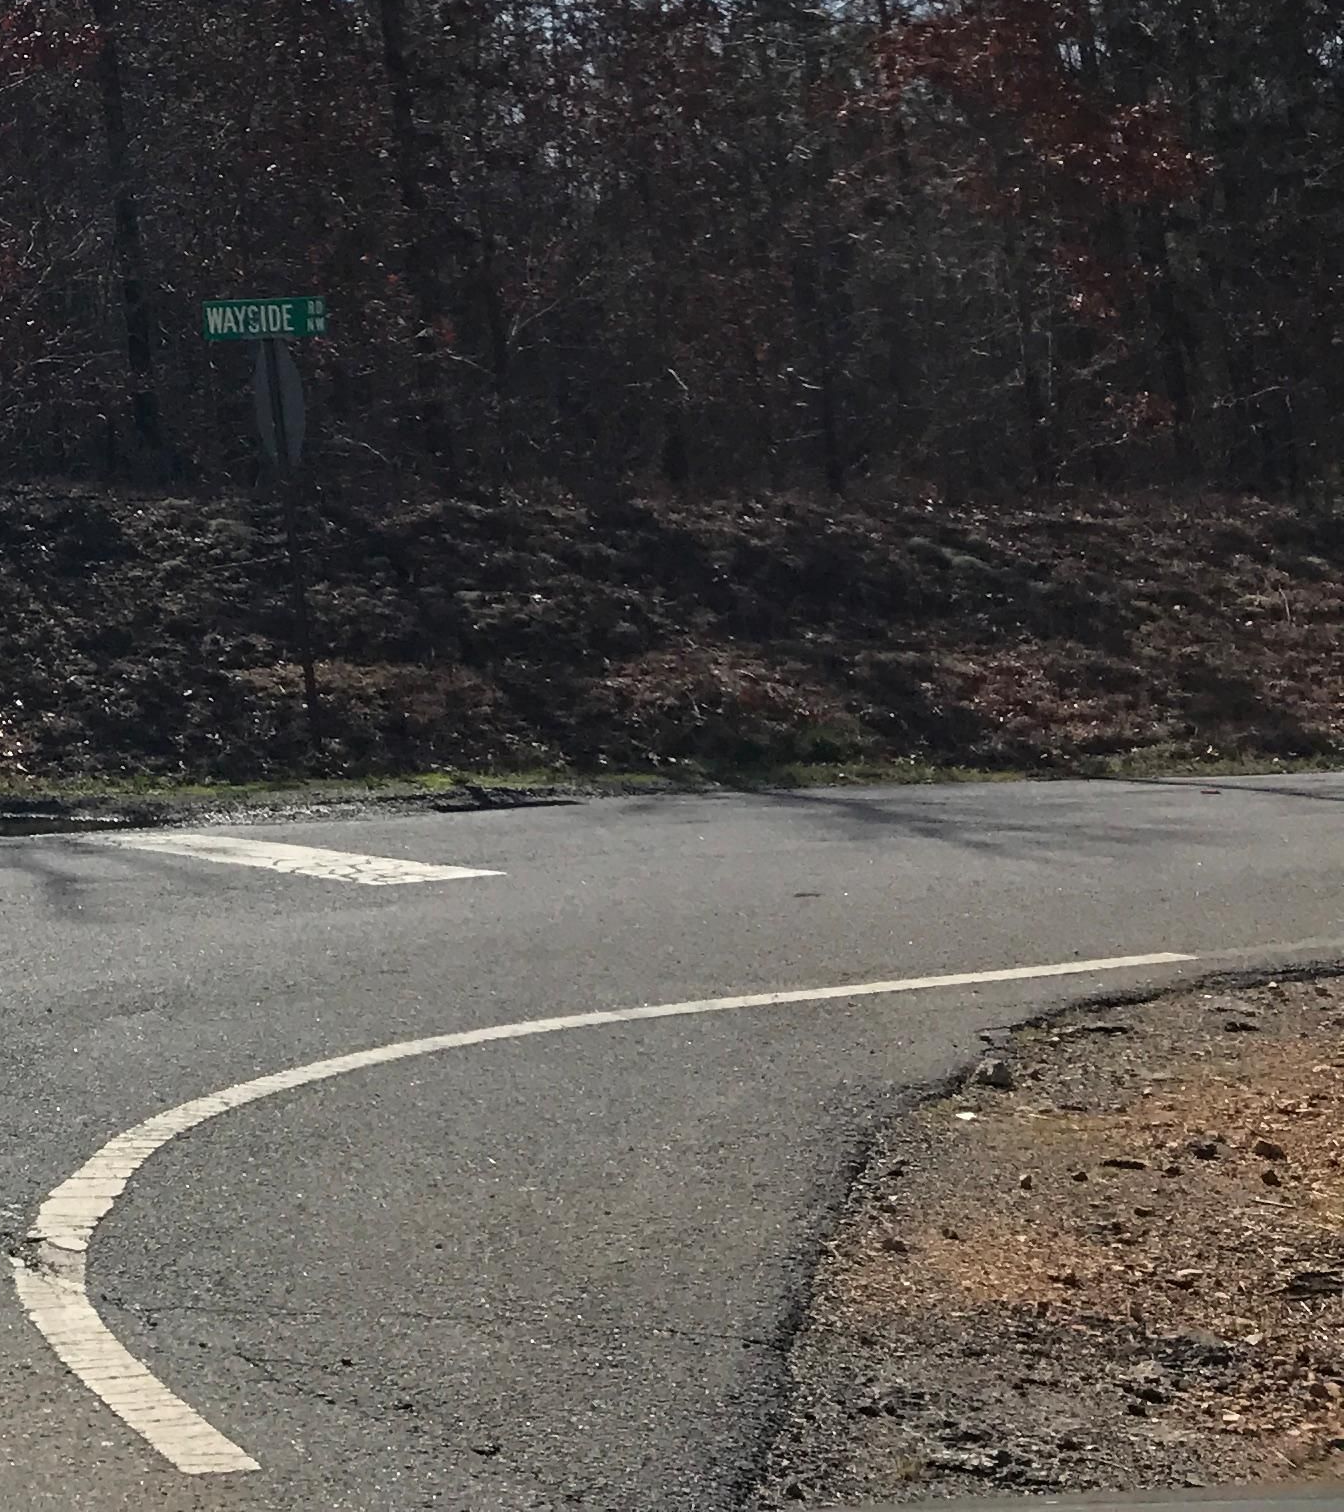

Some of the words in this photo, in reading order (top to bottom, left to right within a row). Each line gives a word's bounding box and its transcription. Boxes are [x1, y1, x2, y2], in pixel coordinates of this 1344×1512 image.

[307, 300, 323, 315] RD
[206, 304, 294, 334] WAYSIDE
[307, 317, 325, 331] NW
